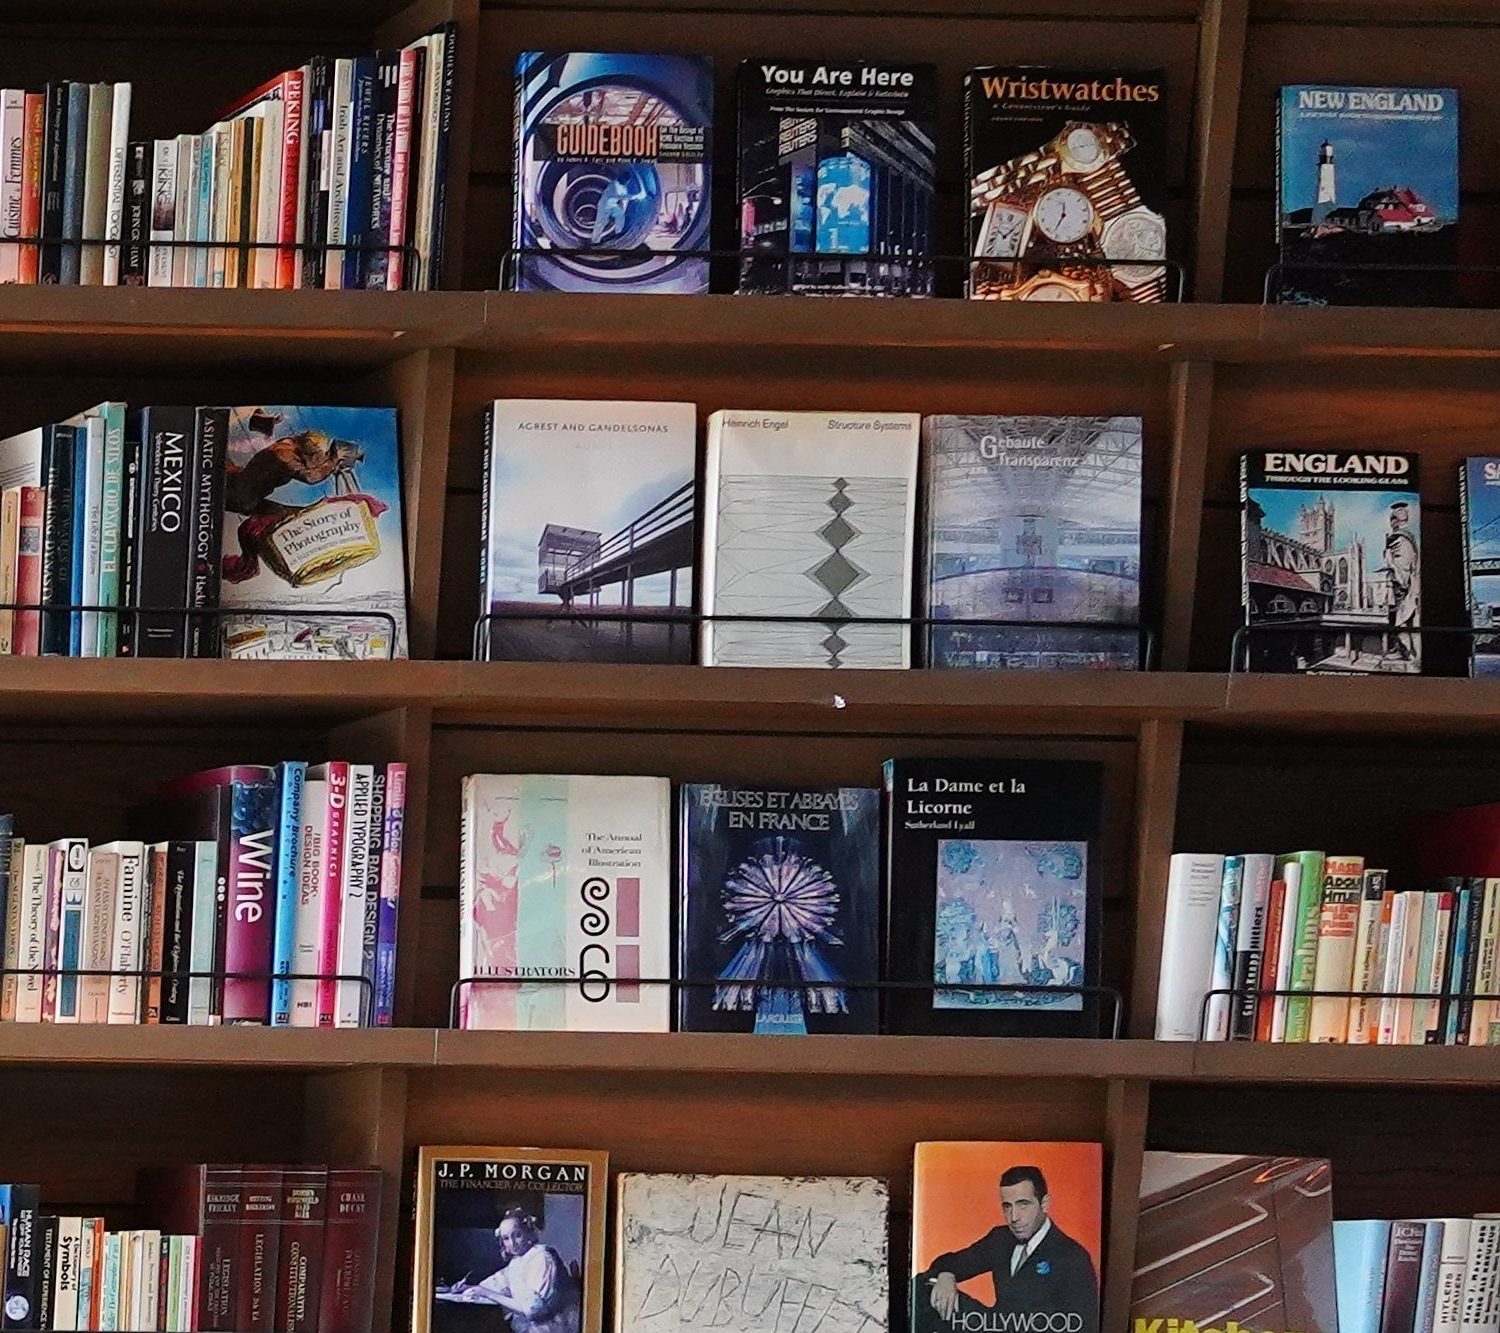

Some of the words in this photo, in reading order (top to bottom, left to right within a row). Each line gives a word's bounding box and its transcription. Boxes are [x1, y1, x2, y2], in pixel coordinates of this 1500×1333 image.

[761, 66, 806, 85] You
[812, 66, 851, 86] Are
[860, 67, 914, 86] Here
[981, 75, 1160, 103] Wristwatches
[1299, 90, 1344, 110] NEW
[1347, 91, 1443, 112] ENGLAND
[1263, 453, 1409, 474] ENGLAND
[161, 431, 183, 533] MEXICO
[907, 778, 928, 793] La
[934, 778, 984, 794] Dame
[988, 780, 1006, 794] et
[1010, 778, 1026, 794] la
[907, 800, 973, 815] Licorne
[235, 829, 275, 923] Wine
[949, 1311, 1083, 1333] HOLLYWOOD
